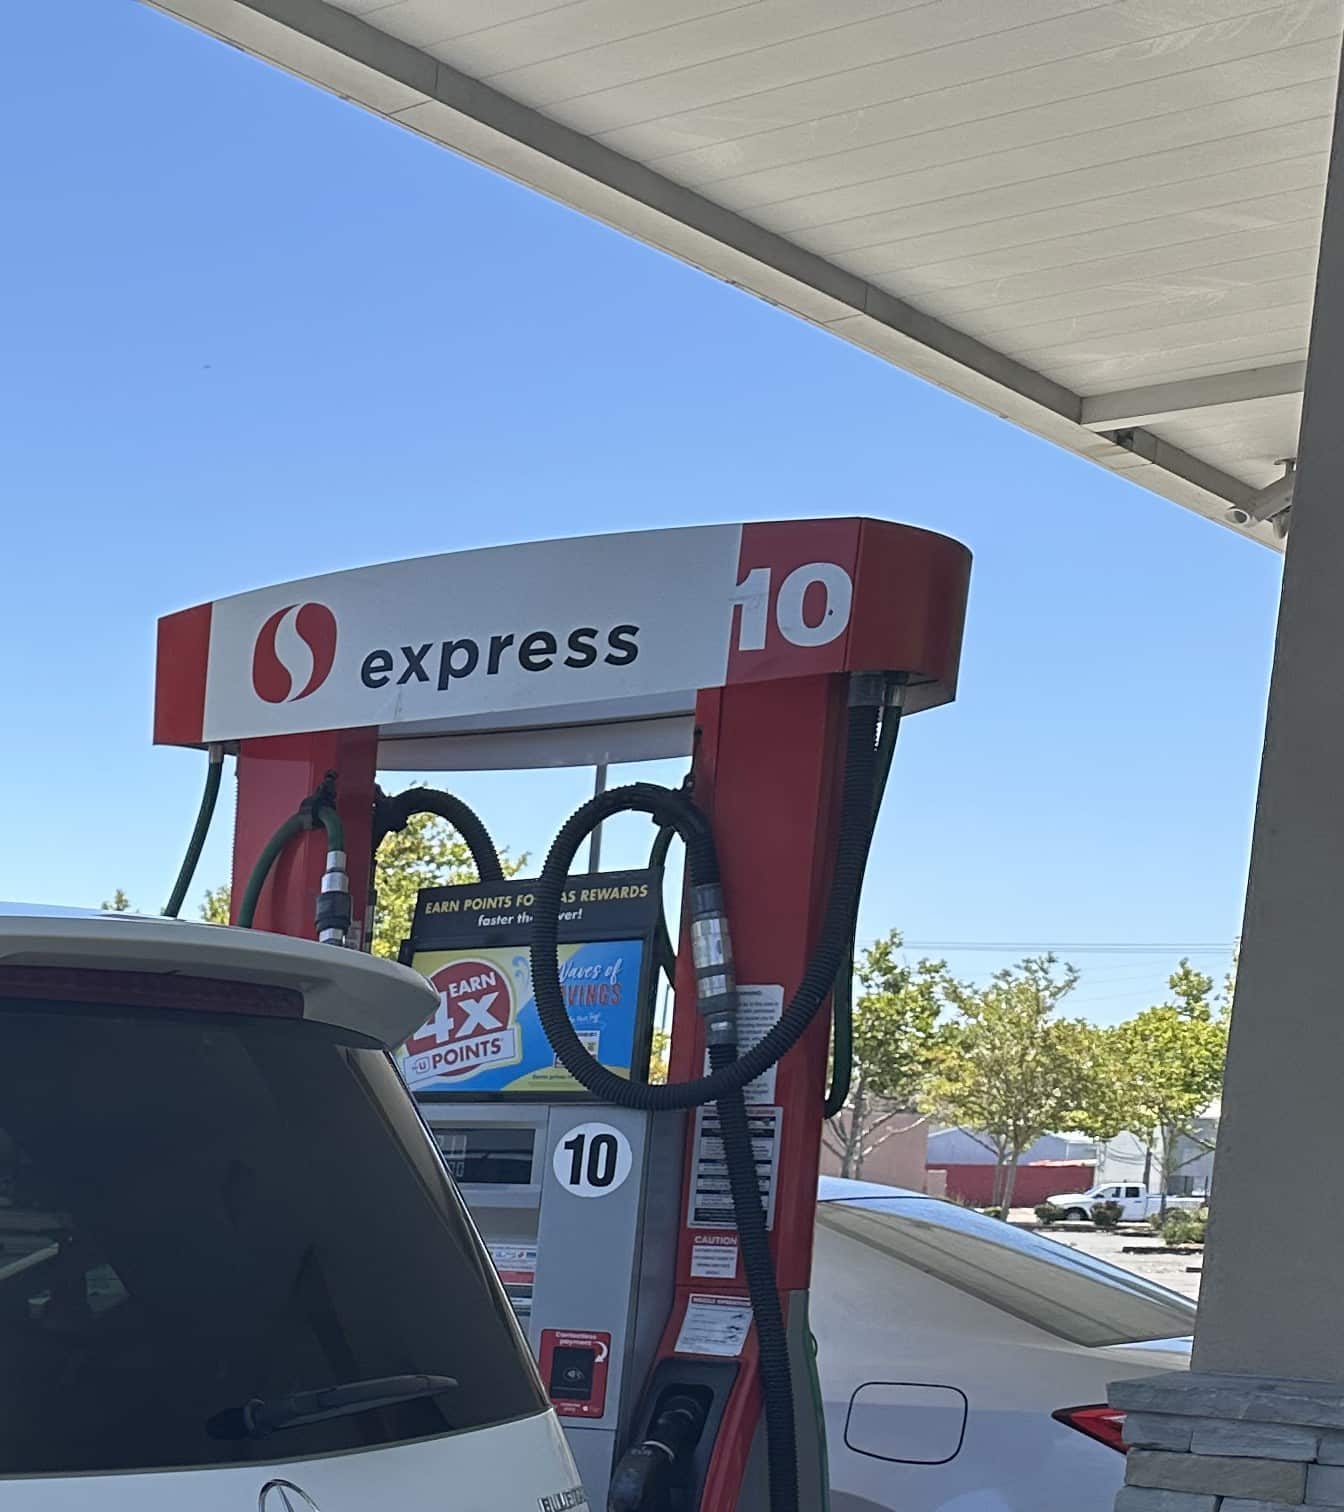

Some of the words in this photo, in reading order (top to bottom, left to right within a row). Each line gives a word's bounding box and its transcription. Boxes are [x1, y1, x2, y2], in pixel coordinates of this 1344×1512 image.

[730, 562, 854, 652] 10
[360, 623, 641, 691] express
[425, 899, 460, 915] EARN
[463, 895, 513, 912] POINTS
[515, 894, 535, 907] FO
[560, 891, 576, 905] AS
[580, 884, 649, 901] REWARDS
[477, 914, 514, 927] faster
[558, 908, 583, 921] ver!
[448, 971, 496, 998] EARN
[604, 958, 624, 985] of
[560, 984, 622, 1007] VINGS
[432, 1038, 502, 1070] POINTS
[564, 1133, 619, 1188] 10
[694, 1234, 738, 1246] CAUTION
